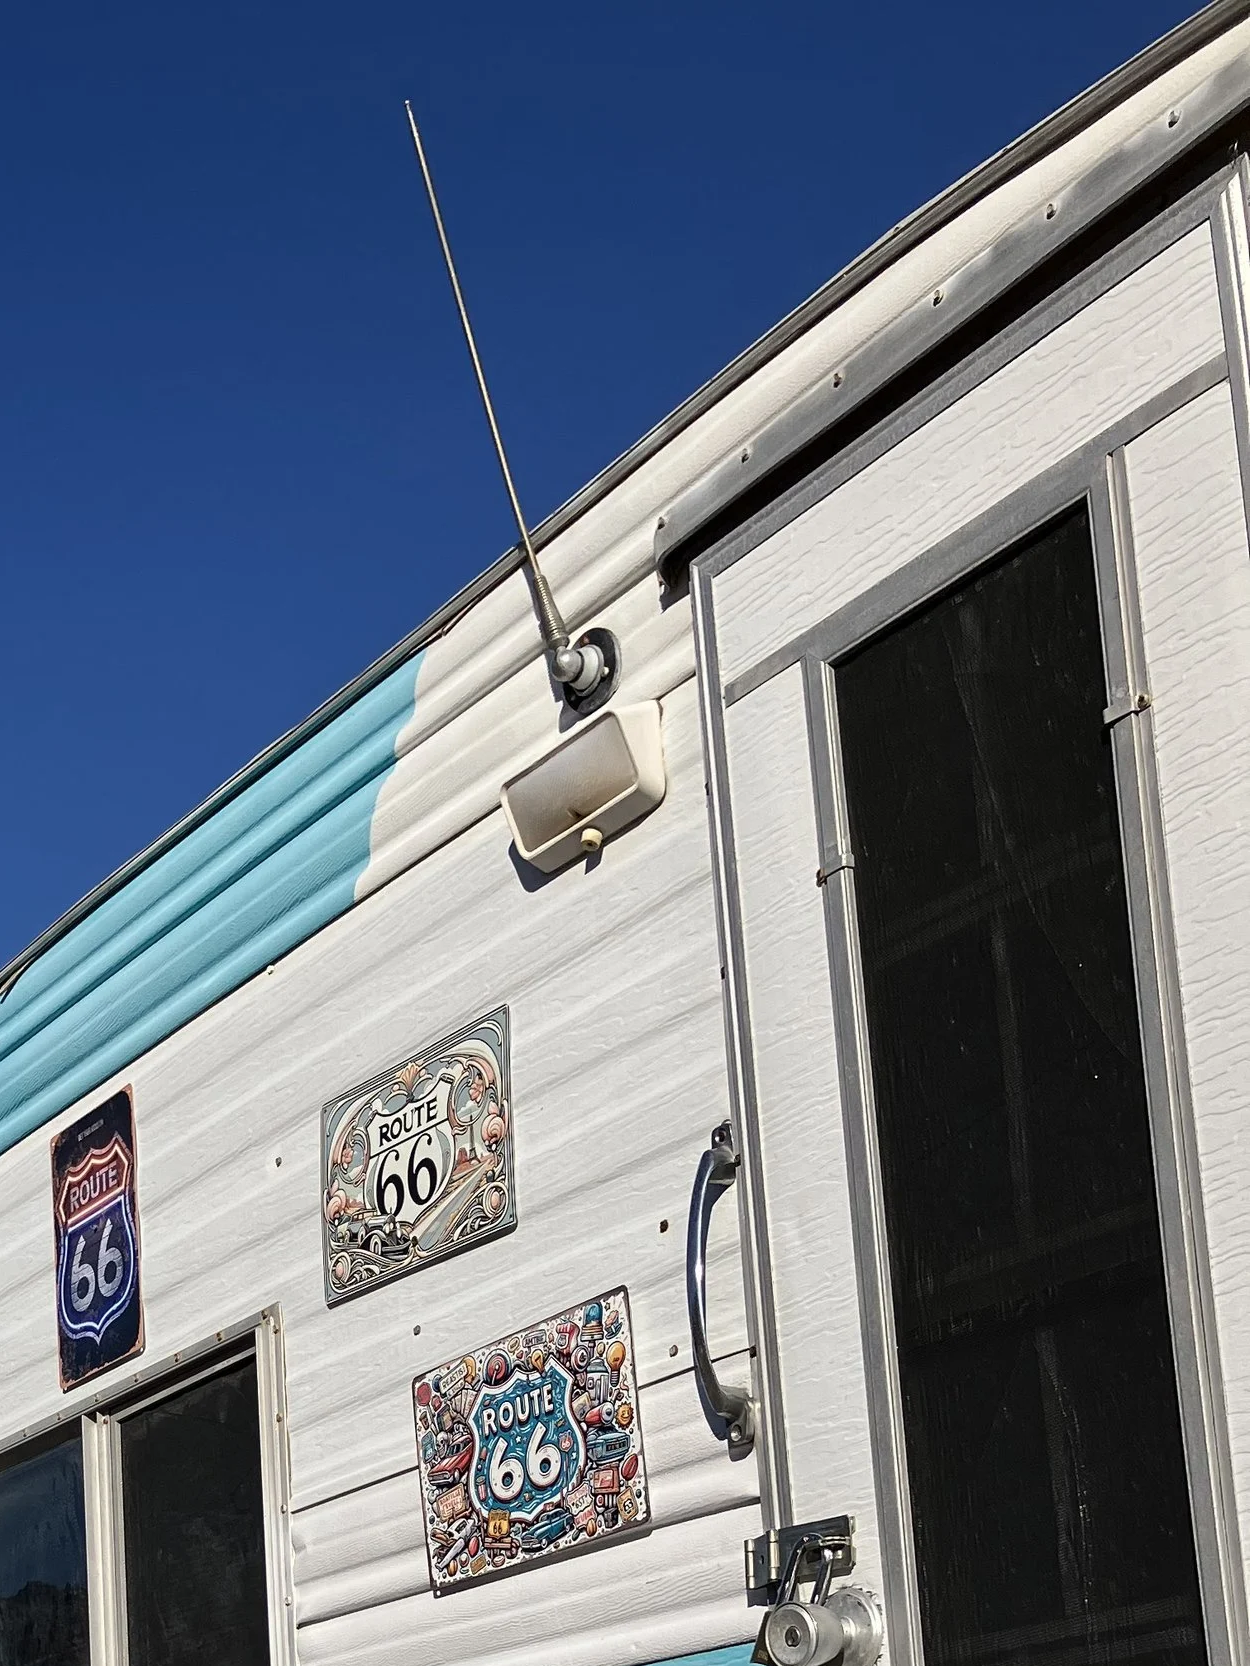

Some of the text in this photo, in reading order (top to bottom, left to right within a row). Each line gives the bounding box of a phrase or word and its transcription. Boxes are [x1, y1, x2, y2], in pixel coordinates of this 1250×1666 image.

[379, 1096, 438, 1147] ROUTE
[69, 1161, 118, 1213] ROUTE
[376, 1132, 438, 1218] 66
[70, 1218, 124, 1313] 66
[481, 1384, 554, 1436] ROUTE
[488, 1422, 562, 1501] 66
